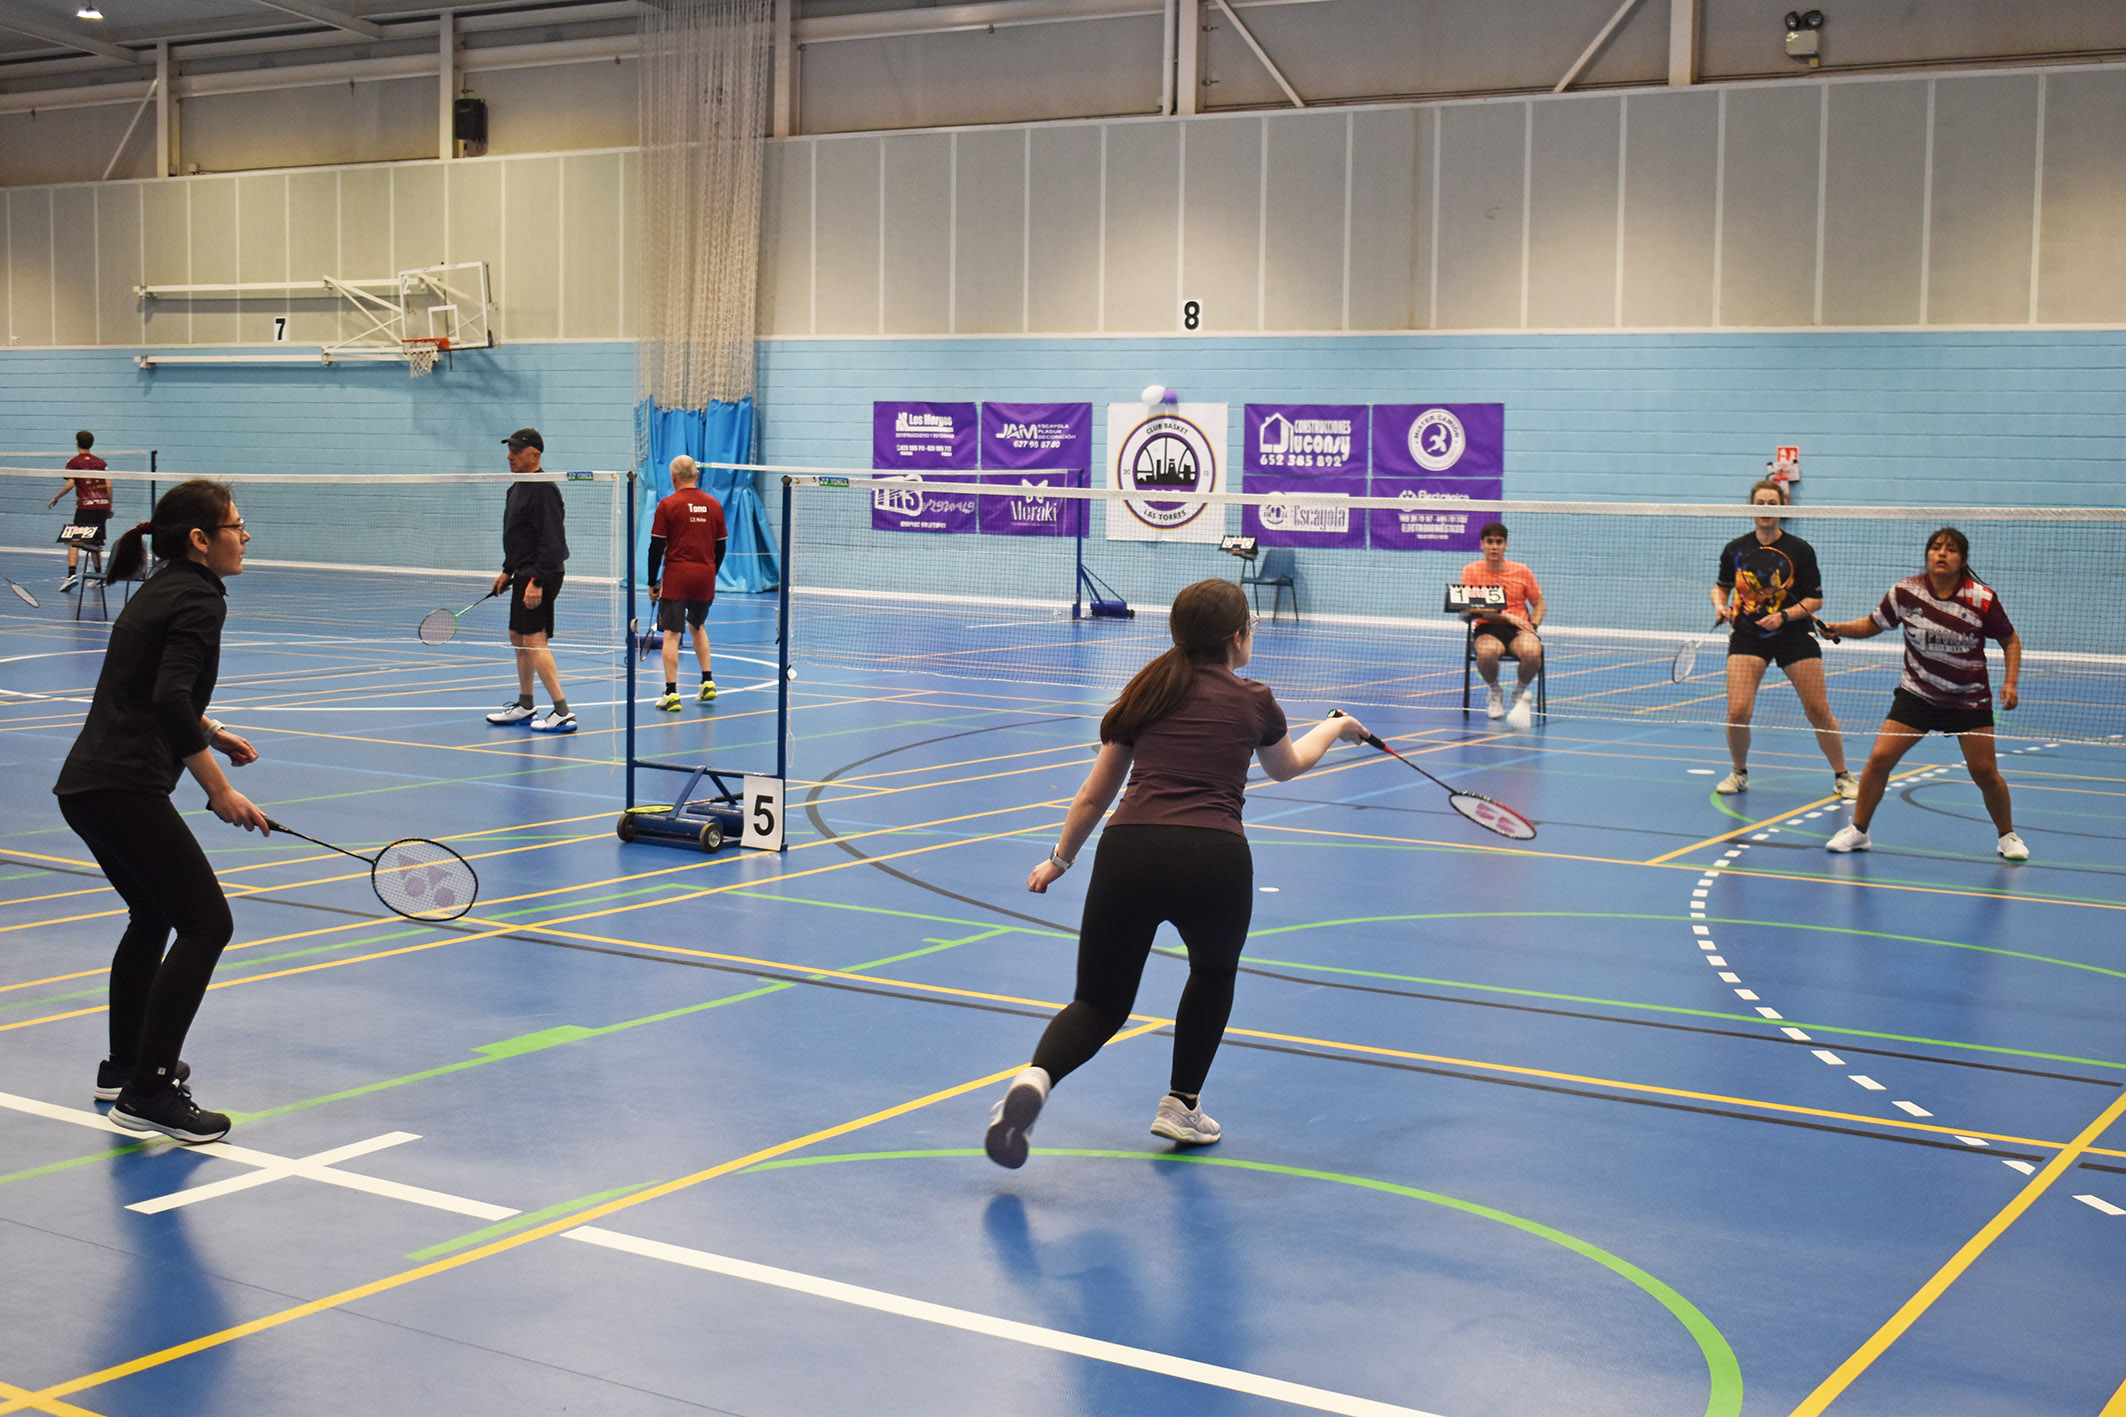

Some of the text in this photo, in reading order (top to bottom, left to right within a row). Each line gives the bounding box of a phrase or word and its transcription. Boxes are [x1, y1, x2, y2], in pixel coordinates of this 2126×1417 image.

[1184, 300, 1200, 330] 8
[275, 318, 286, 340] 7
[996, 422, 1038, 440] JAM
[1146, 423, 1188, 435] CLUB BASKET
[1013, 440, 1028, 449] 627
[1260, 454, 1285, 466] 652
[1316, 455, 1342, 467] 892
[1144, 509, 1187, 521] LAS TORRES
[1293, 504, 1346, 530] Escayola
[1456, 589, 1463, 601] 1
[1489, 589, 1501, 602] 5
[753, 794, 774, 836] 5
